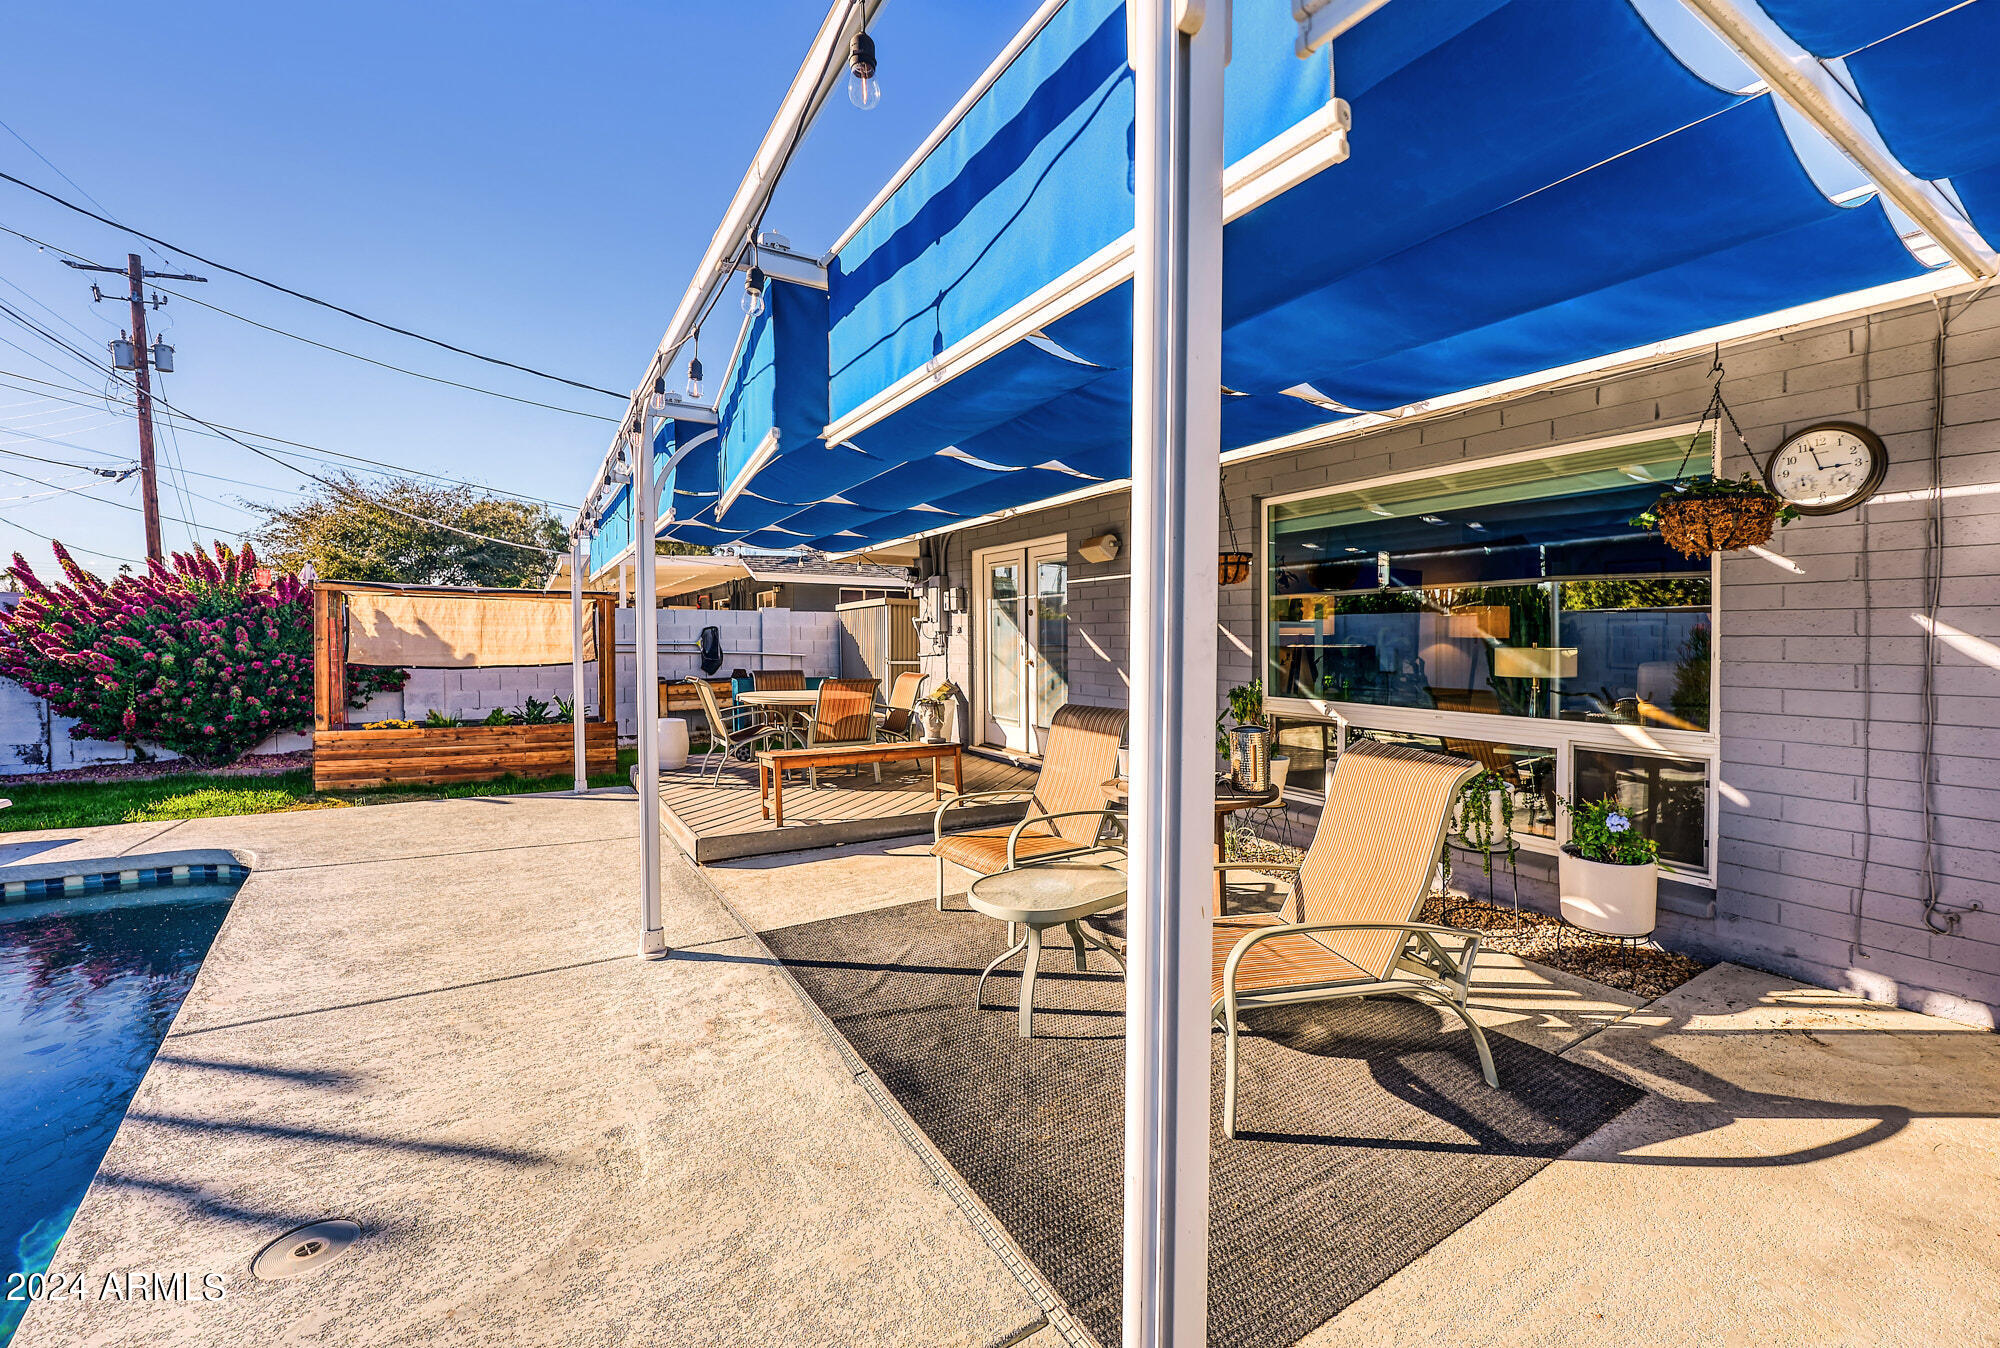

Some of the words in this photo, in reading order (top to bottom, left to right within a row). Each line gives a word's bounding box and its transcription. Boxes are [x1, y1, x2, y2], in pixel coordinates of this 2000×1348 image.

[1815, 437, 1827, 447] 12
[1798, 444, 1808, 454] 11
[1849, 445, 1858, 455] 2
[1786, 456, 1797, 466] 10
[1854, 457, 1863, 467] 3
[1782, 469, 1790, 479] 9
